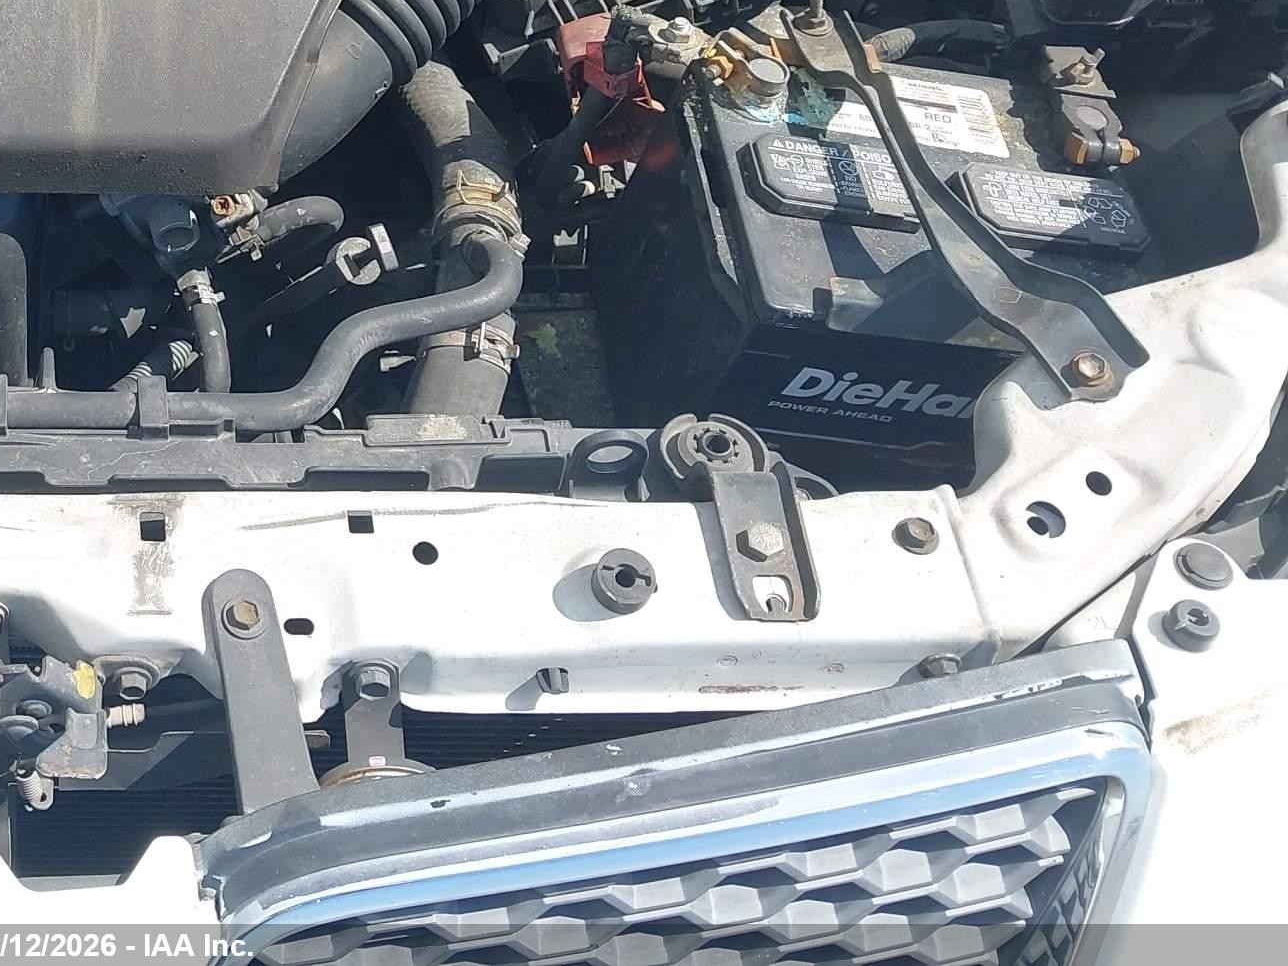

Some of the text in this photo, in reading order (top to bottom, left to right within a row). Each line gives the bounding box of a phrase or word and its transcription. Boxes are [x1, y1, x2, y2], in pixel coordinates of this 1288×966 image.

[924, 112, 952, 124] RED
[784, 140, 839, 158] DANGER
[853, 149, 892, 164] POISO
[767, 400, 893, 422] POWER AHEAD
